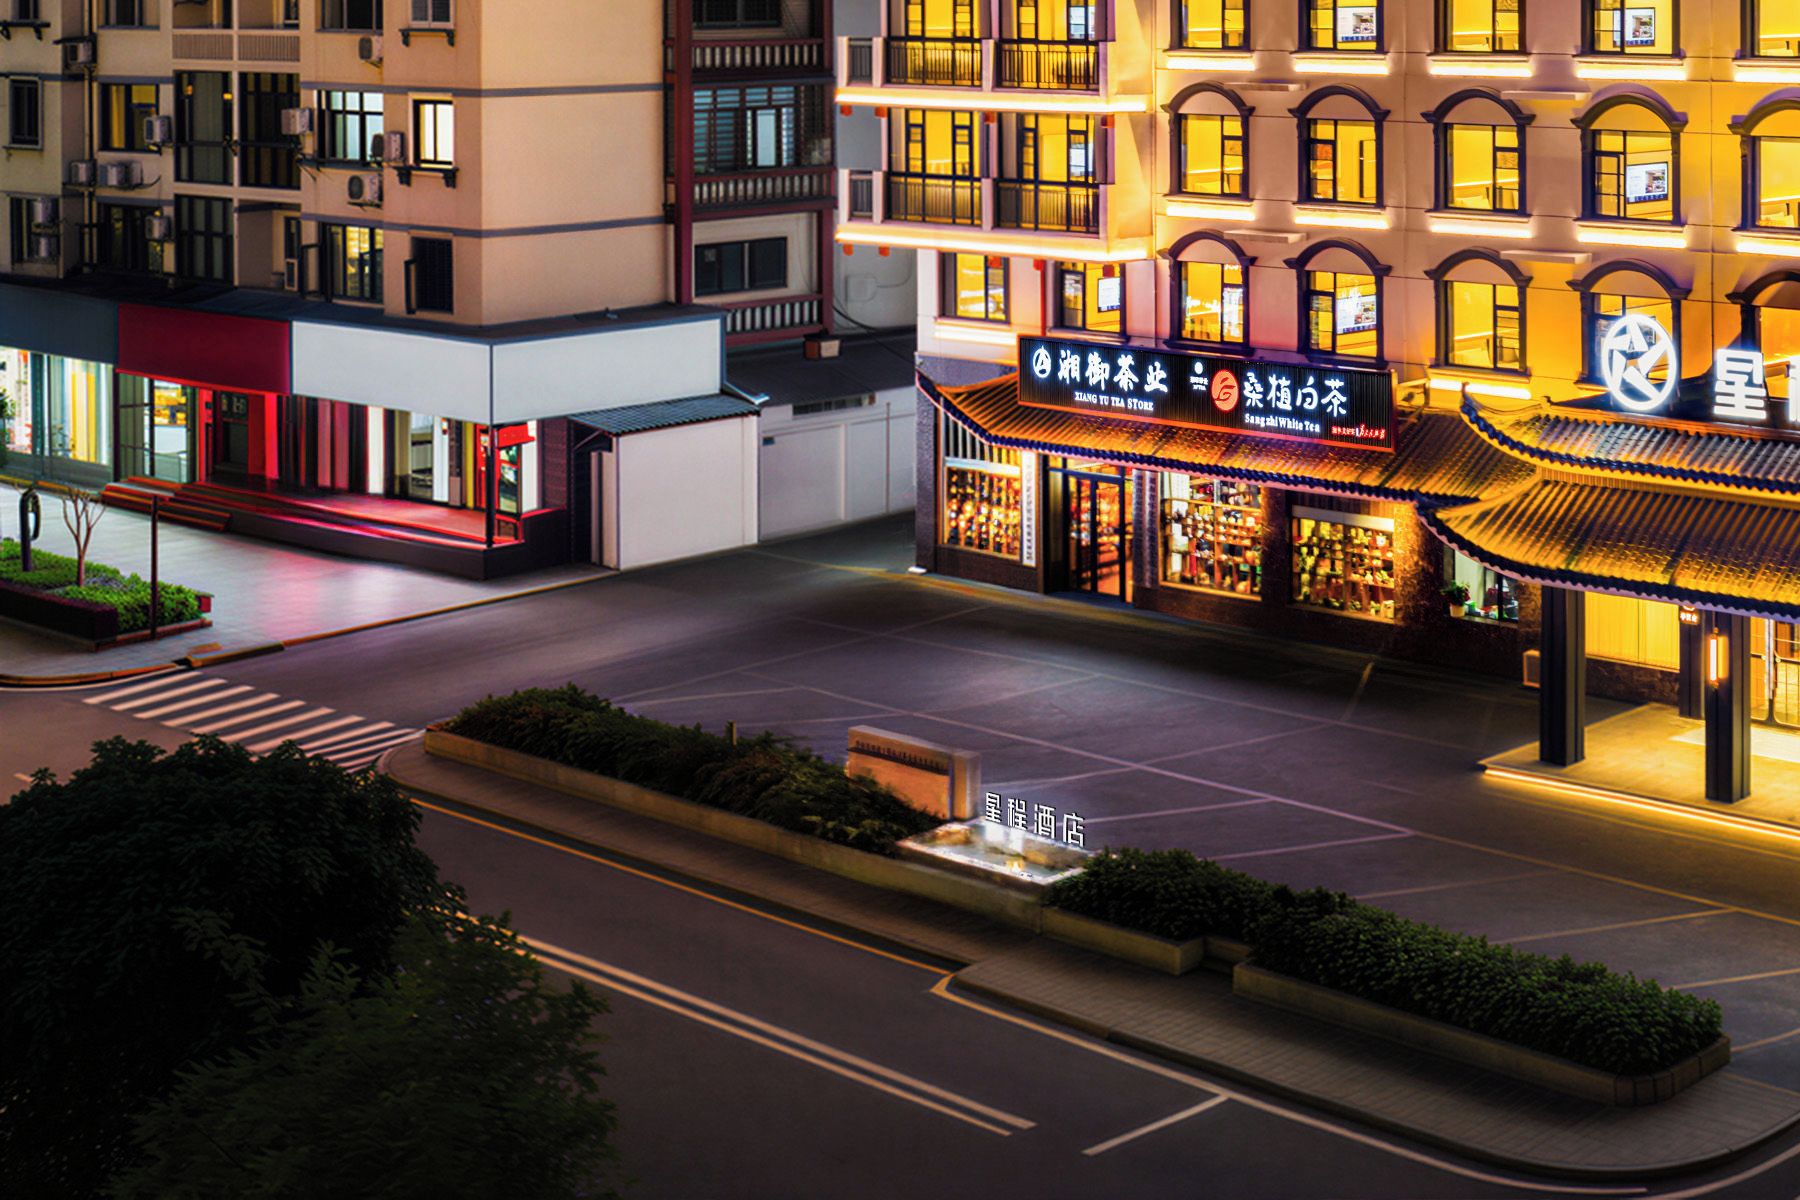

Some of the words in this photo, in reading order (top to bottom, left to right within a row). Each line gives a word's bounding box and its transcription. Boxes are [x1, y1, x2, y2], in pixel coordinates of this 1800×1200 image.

[1057, 349, 1169, 393] 湘御茶业
[1074, 391, 1098, 404] XIANG
[1099, 394, 1109, 405] YU
[1111, 396, 1125, 407] TEA
[1127, 398, 1154, 411] STORE
[1243, 371, 1348, 418] 桑植白茶
[1304, 420, 1321, 433] Tea
[984, 792, 1084, 848] 星程酒店
